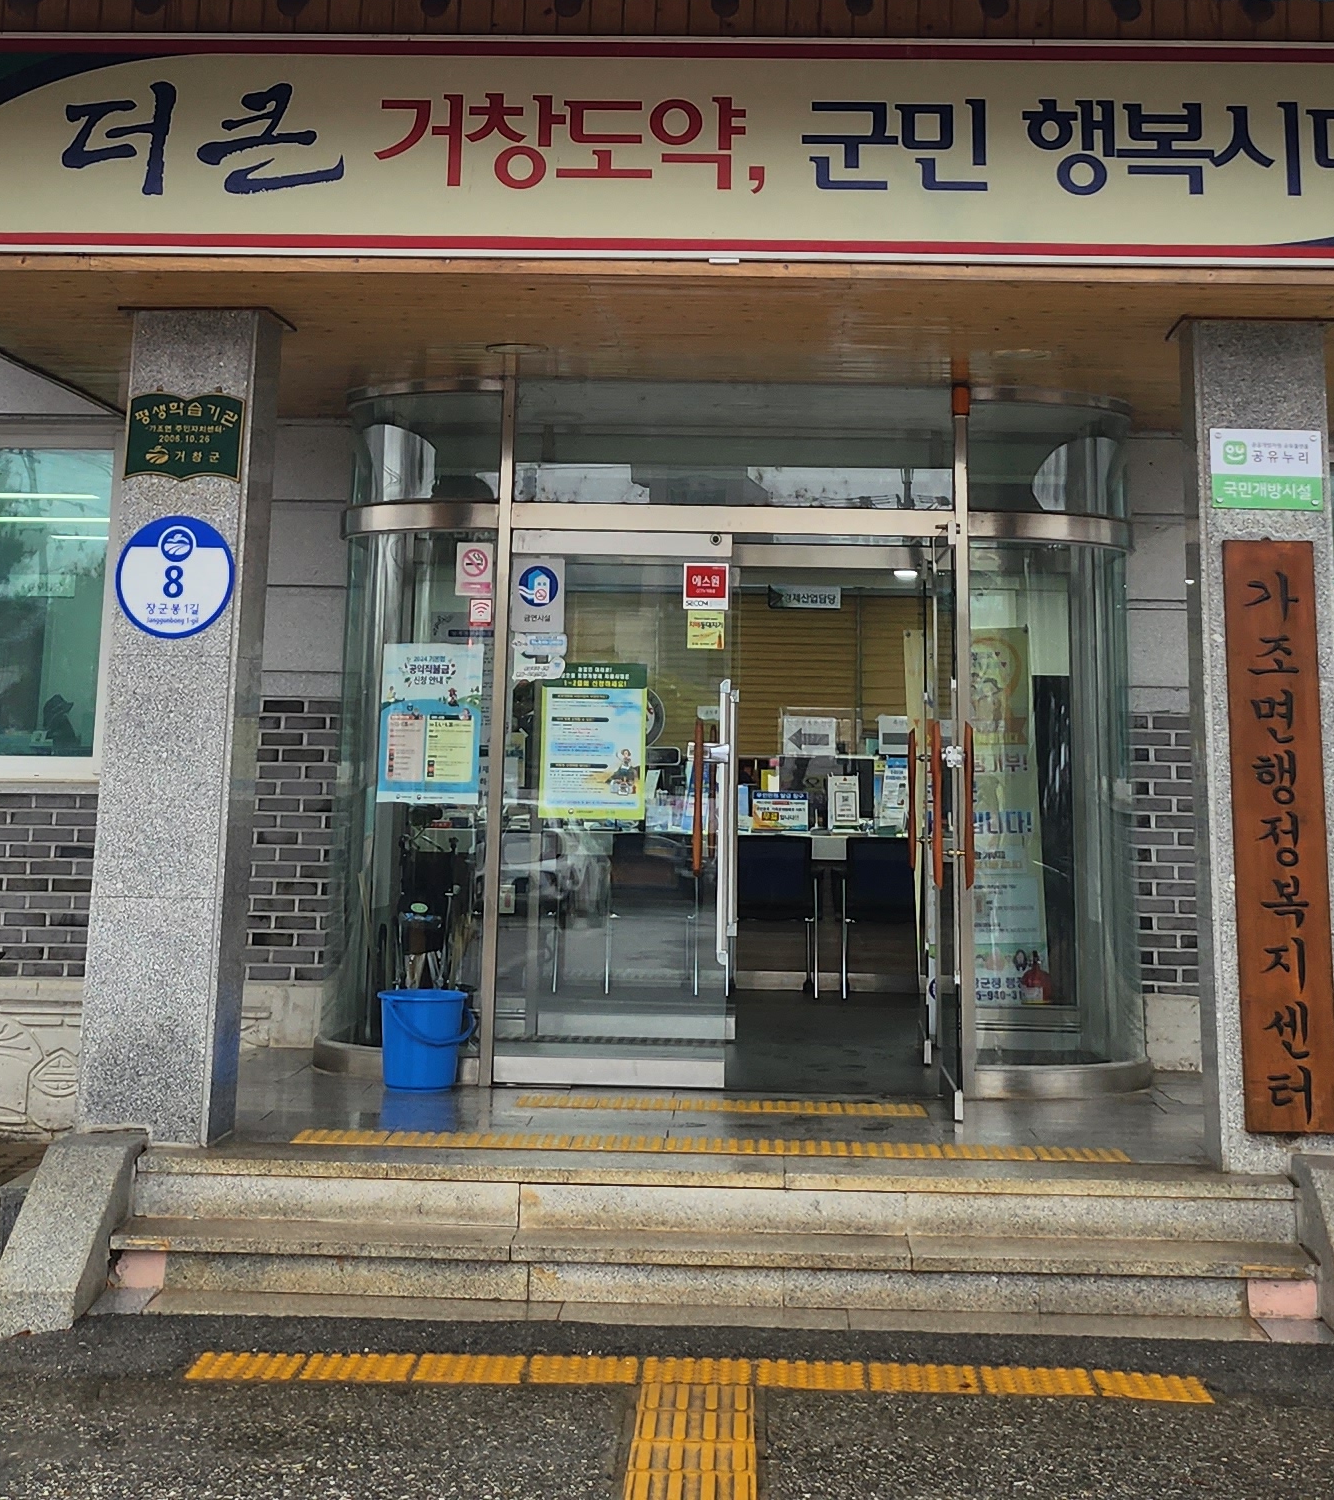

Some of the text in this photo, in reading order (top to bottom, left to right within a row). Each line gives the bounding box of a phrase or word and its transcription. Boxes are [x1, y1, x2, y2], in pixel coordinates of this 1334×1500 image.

[63, 81, 171, 197] 더
[200, 85, 346, 197] 큰
[373, 95, 767, 193] 거창도약,
[800, 99, 988, 193] 군민
[134, 402, 238, 427] 평생학습기관
[148, 425, 172, 433] 가조면
[175, 450, 220, 463] 거창군
[1251, 450, 1309, 464] 공유누리
[1223, 481, 1312, 500] 국민개방시설
[163, 565, 184, 598] 8
[691, 575, 720, 587] 에스원
[524, 614, 551, 622] 금연시설
[409, 663, 450, 675] 공익직불금
[414, 676, 444, 685] 신청 안내
[975, 977, 1001, 989] 군청
